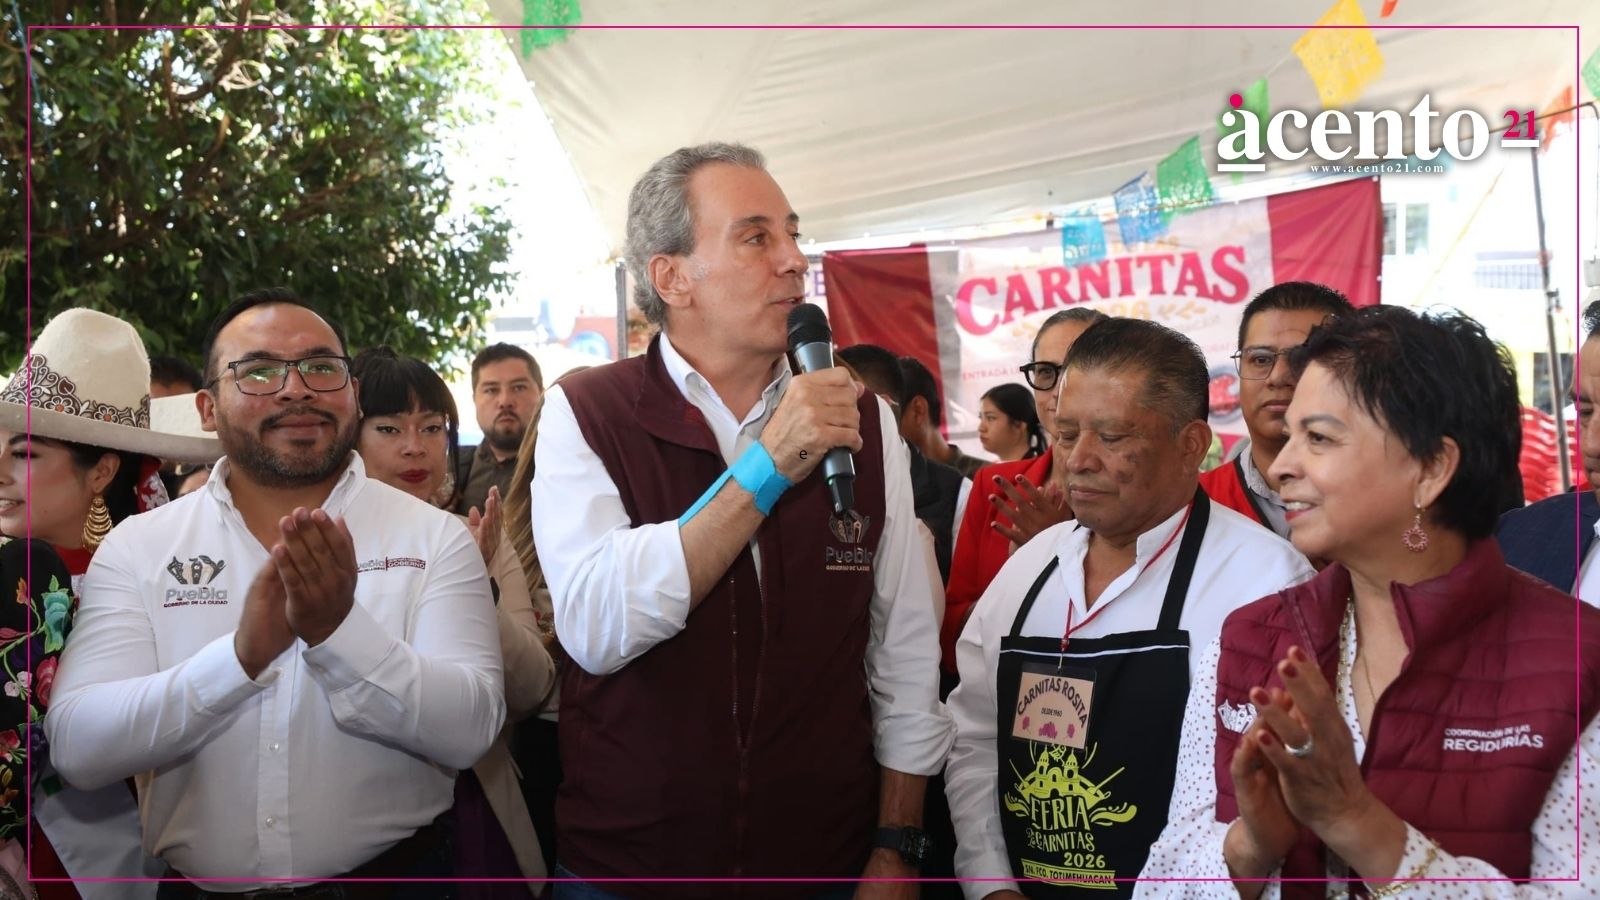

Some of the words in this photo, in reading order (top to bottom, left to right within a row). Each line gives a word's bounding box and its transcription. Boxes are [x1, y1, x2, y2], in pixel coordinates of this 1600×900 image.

[955, 245, 1249, 336] CARNITAS
[163, 600, 190, 608] GOBIERNO
[165, 586, 228, 602] Puebla
[1017, 677, 1062, 715] CARNITAS
[1061, 680, 1088, 728] ROSITA
[1031, 796, 1091, 831] FERIA
[1035, 831, 1095, 852] CARNITAS
[1063, 852, 1106, 868] 2026
